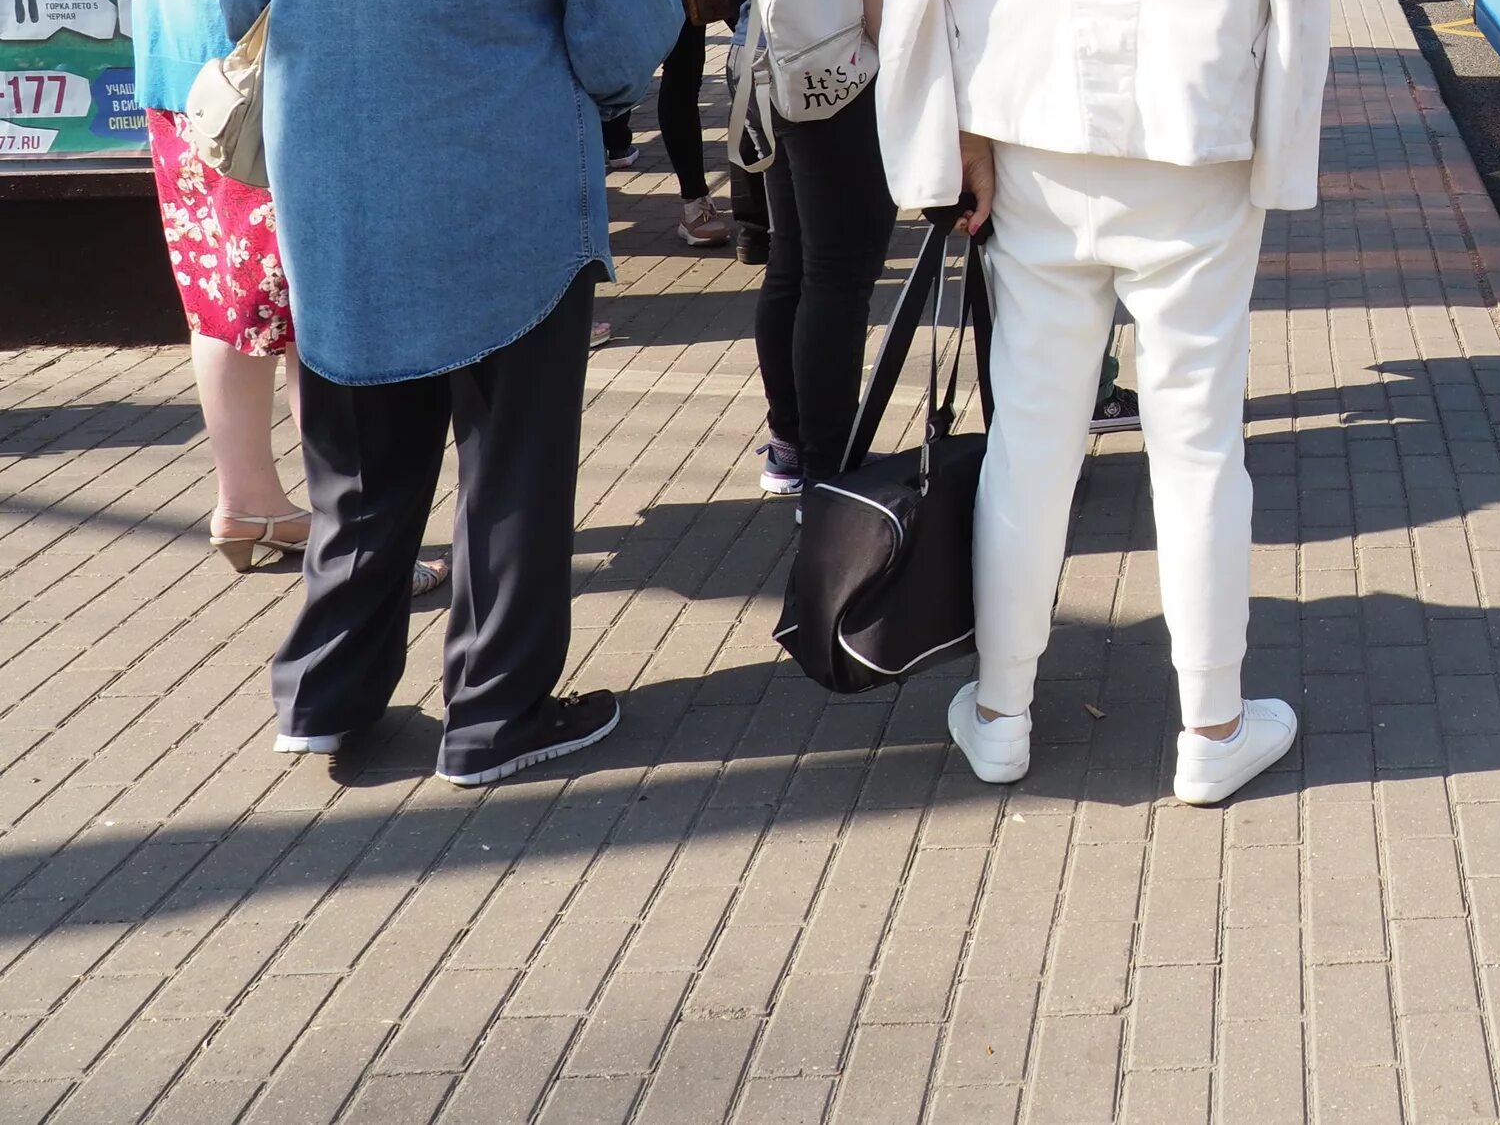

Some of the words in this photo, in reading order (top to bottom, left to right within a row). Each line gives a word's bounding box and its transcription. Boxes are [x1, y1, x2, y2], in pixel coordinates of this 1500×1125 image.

[45, 2, 70, 10] ГОРКА
[71, 2, 92, 10] ЛЕТО
[46, 12, 76, 20] ЧЕРНАЯ
[112, 100, 120, 112] В
